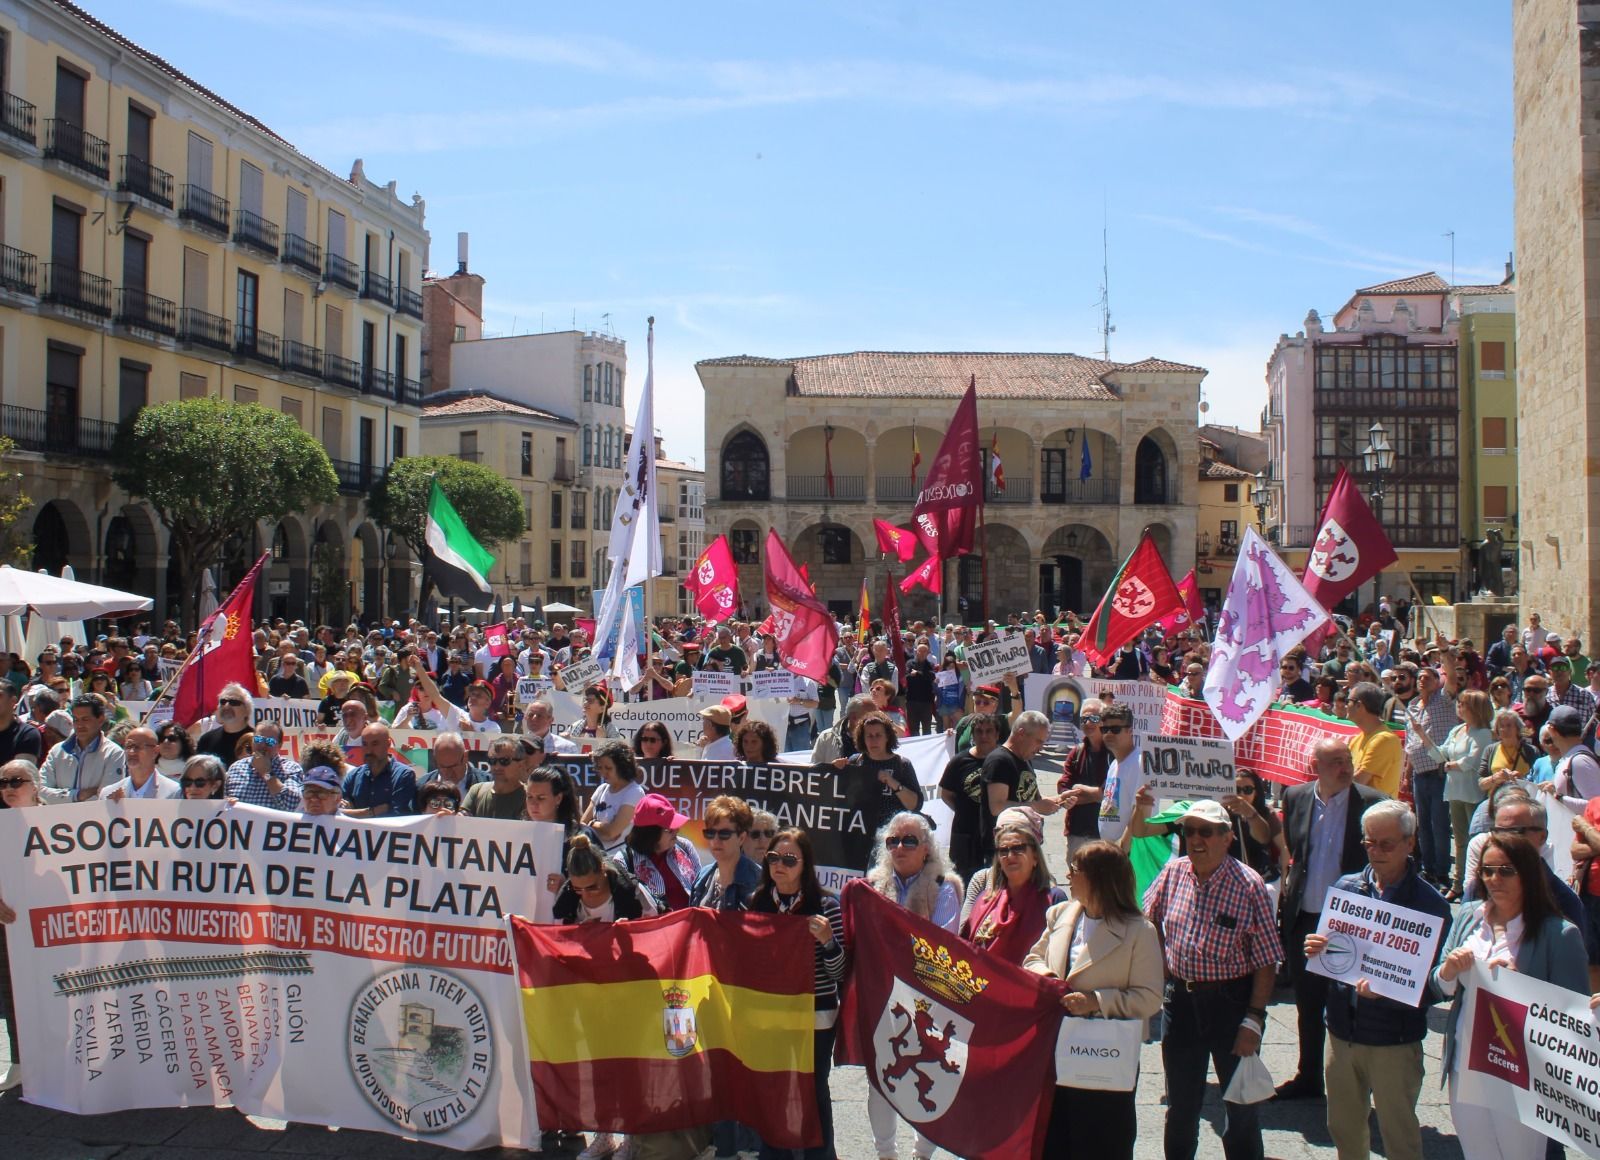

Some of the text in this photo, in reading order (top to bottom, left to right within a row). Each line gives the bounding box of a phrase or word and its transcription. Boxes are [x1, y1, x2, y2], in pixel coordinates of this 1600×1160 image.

[967, 649, 995, 673] NO
[996, 646, 1028, 665] MURO
[520, 682, 536, 695] NO
[562, 669, 579, 685] NO
[1138, 684, 1154, 697] POR
[284, 708, 302, 727] UN
[302, 708, 318, 727] TR
[1147, 735, 1198, 746] NAVALMORAL
[1142, 747, 1194, 776] NO AL
[1185, 758, 1234, 780] MURO
[24, 811, 537, 876] ASOCIACIÓN BENAVENTANA
[61, 860, 504, 919] TREN RUTA DE LA PLATA
[1329, 896, 1432, 938] El Oeste NO puede
[41, 907, 513, 967] ¡NECESITAMOS NUESTRO TREN, ES NUESTRO FUTURO!
[1328, 918, 1421, 957] esperar al 2050.
[1360, 963, 1416, 989] Ruta de la Plata YA
[1362, 953, 1412, 976] Reapertura tren
[103, 999, 126, 1060] ZAFRA
[129, 993, 153, 1064] MÉRIDA
[214, 988, 245, 1062] ZAMORA
[271, 987, 280, 1037] LEÓN
[285, 984, 309, 1044] GIJÓN
[1529, 1003, 1592, 1037] CÁCERES
[86, 1004, 102, 1081] SEVILLA
[154, 989, 180, 1075] CÁCERES
[178, 992, 208, 1089] PLASENCIA
[196, 991, 233, 1099] SALAMANCA
[237, 984, 259, 1082] BENAVEN
[353, 973, 487, 1128] ASOCIACIÓN BENAVENTANA TREN RUTA DE LA PLATA
[1070, 1045, 1120, 1058] MANGO
[1529, 1028, 1600, 1067] LUCHAND
[1487, 1052, 1519, 1073] Cáceres
[1545, 1061, 1600, 1098] QUE NO
[1536, 1104, 1570, 1133] RUTA
[1574, 1122, 1592, 1144] DE
